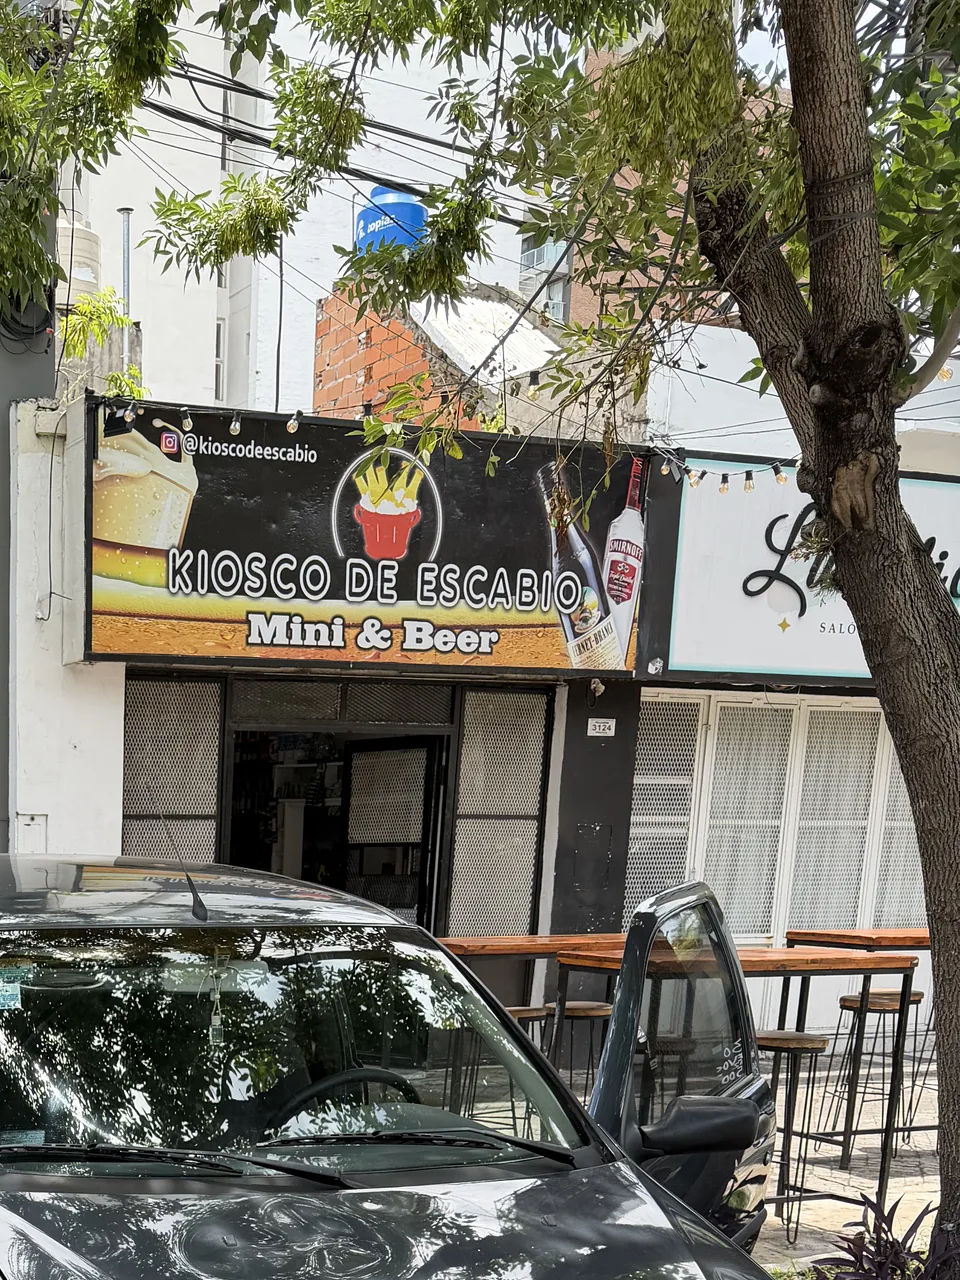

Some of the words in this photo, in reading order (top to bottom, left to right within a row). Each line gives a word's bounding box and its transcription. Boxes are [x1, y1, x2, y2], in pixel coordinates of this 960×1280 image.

[182, 432, 318, 464] @kioscodeescabio
[610, 540, 643, 561] SMIRNOFF
[168, 547, 331, 601] KIOSCO
[345, 557, 399, 605] DE
[416, 561, 583, 615] ESCABIO
[247, 613, 345, 648] Mini
[356, 617, 392, 650] &
[401, 619, 500, 654] Beer
[819, 621, 857, 635] SALÓ
[591, 723, 612, 732] 3124
